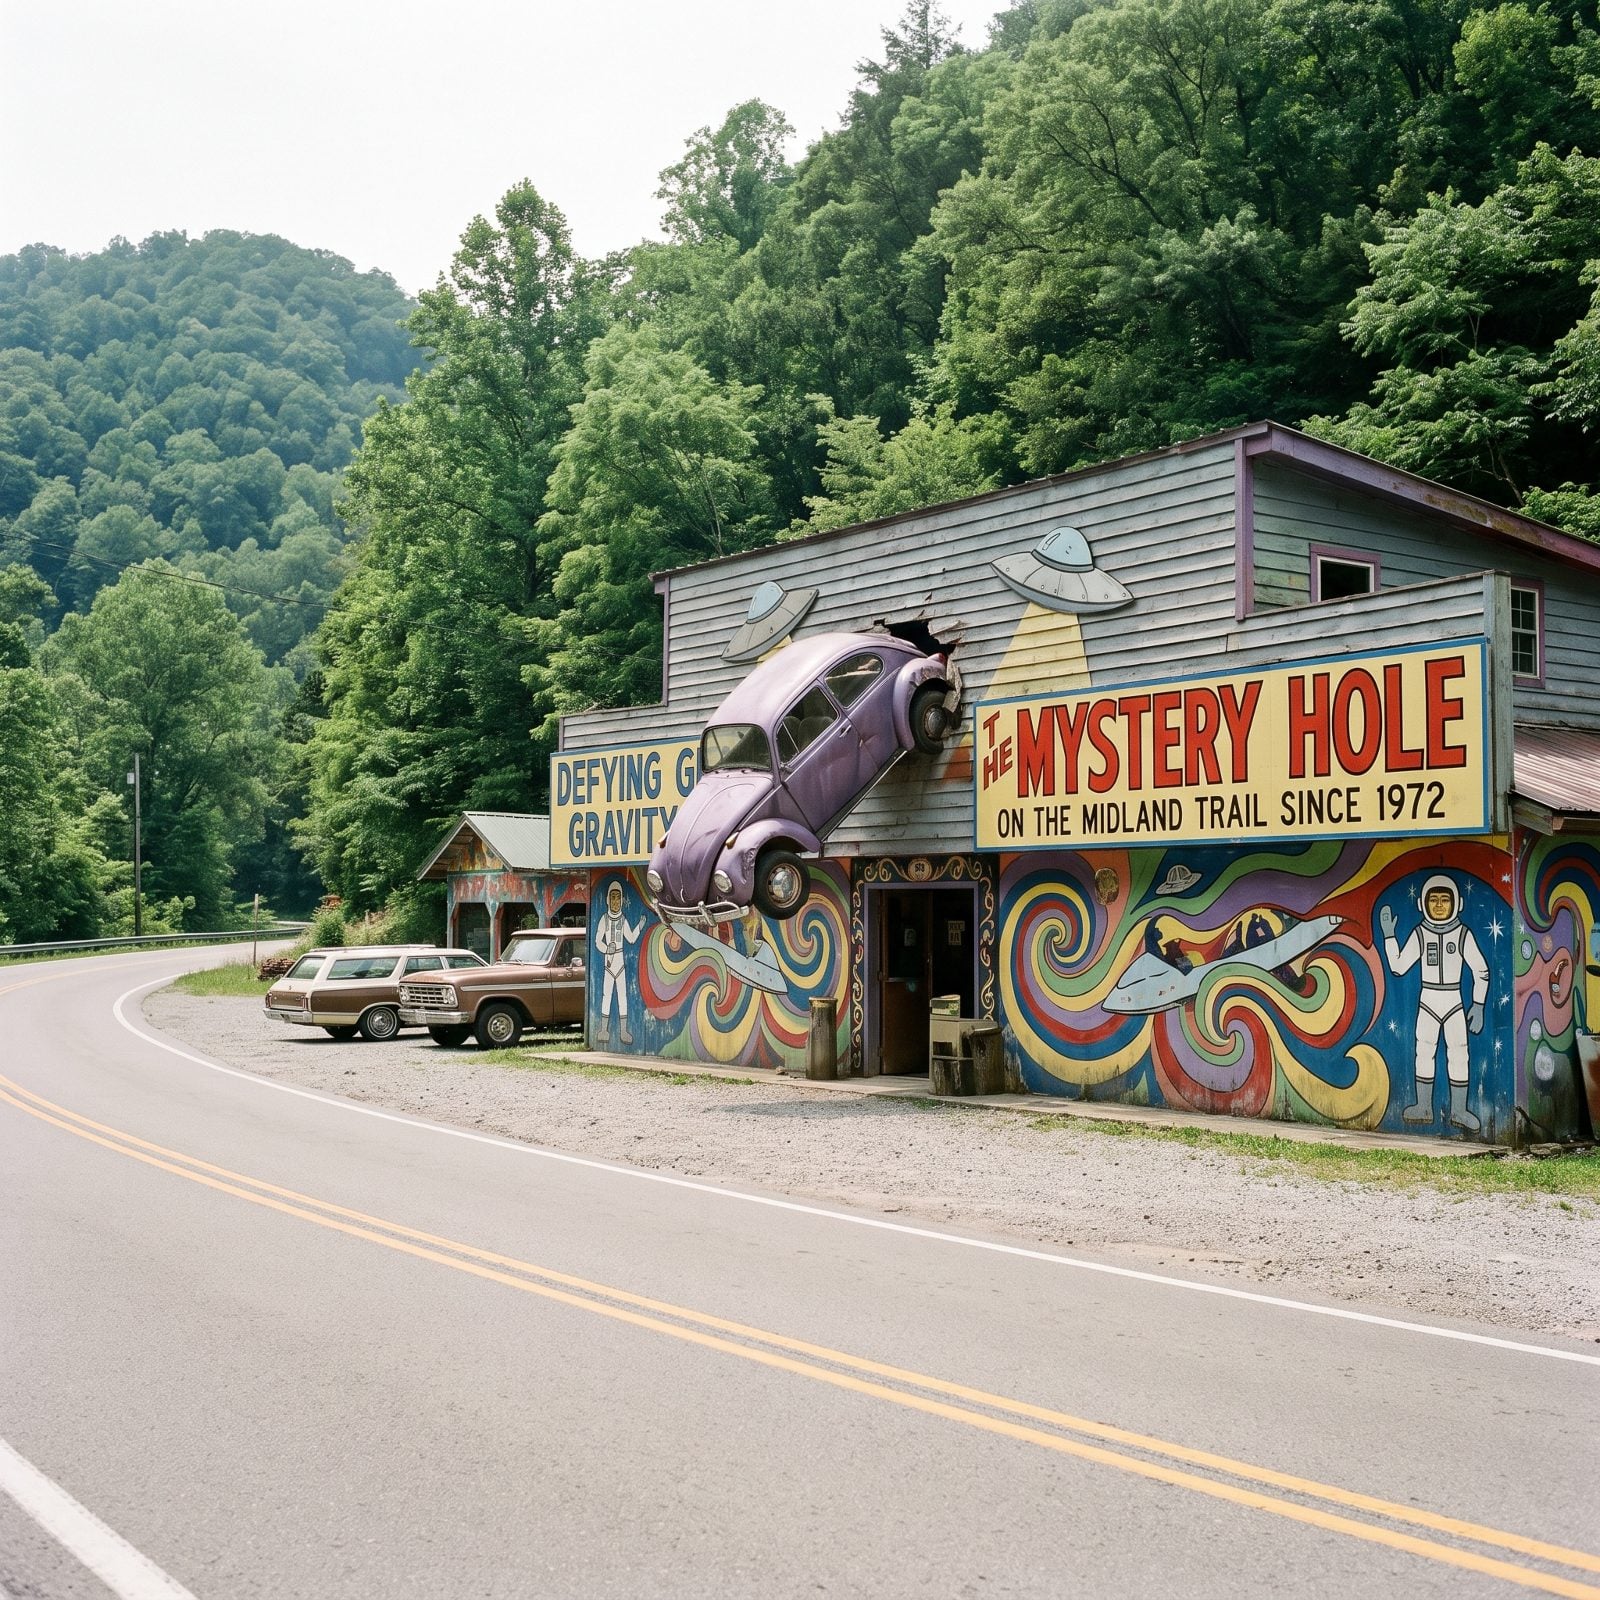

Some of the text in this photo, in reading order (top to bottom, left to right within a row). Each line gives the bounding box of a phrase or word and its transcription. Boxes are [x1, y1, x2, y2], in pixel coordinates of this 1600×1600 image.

[983, 655, 1466, 798] THE MYSTERY HOLE
[557, 747, 702, 806] DEFYING G
[998, 780, 1446, 838] ON THE MIDLAND TRAIL SINCE 1972
